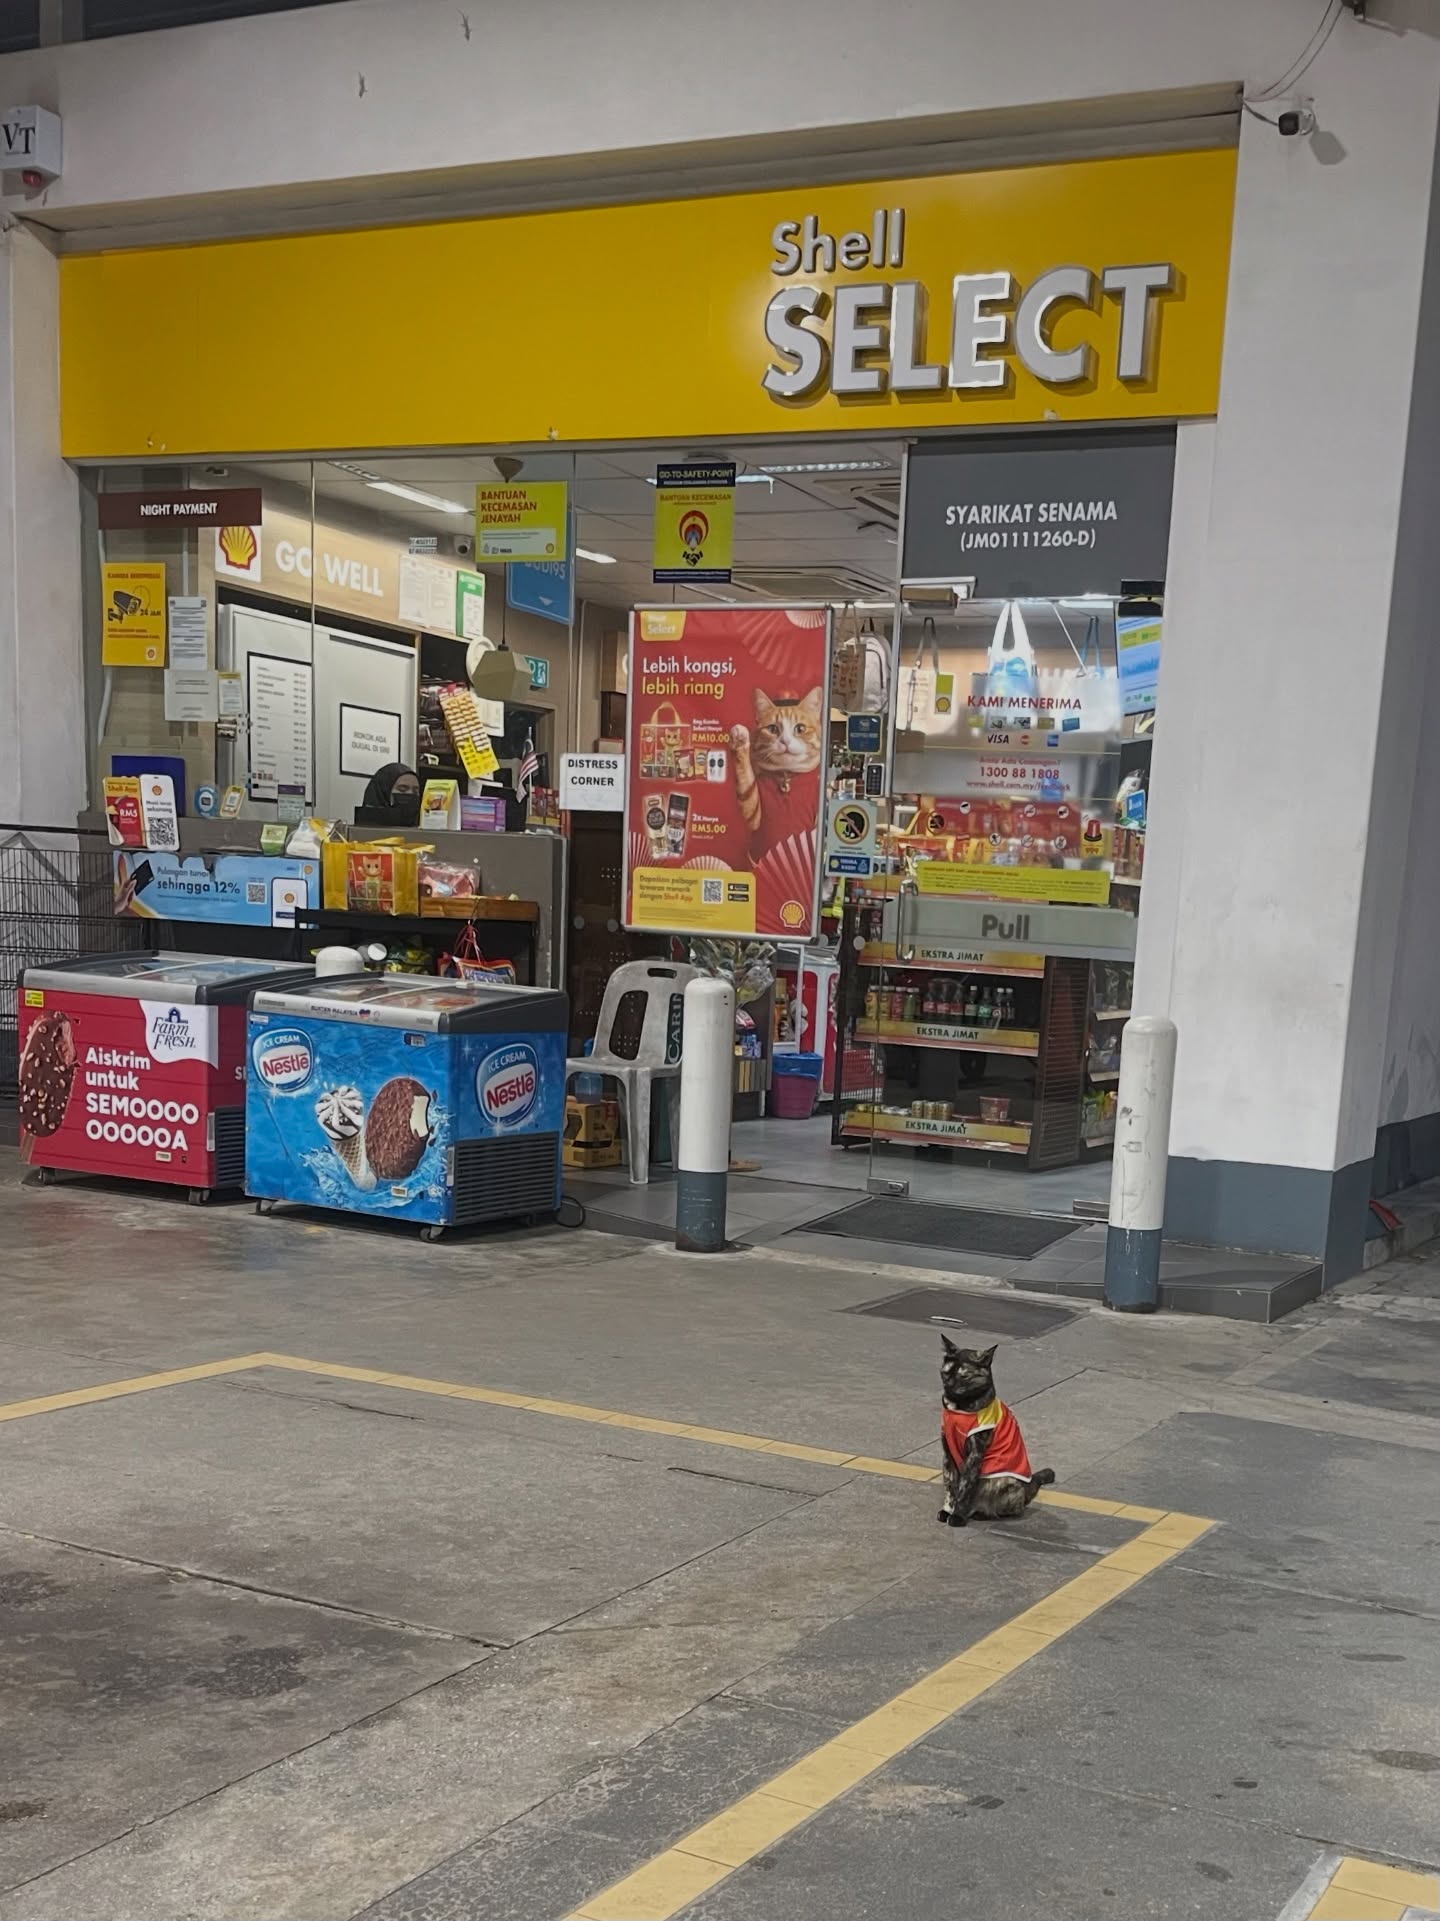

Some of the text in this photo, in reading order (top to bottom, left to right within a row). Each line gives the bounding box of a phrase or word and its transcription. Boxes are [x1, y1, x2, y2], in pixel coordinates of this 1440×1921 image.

[771, 208, 905, 275] Shell
[762, 262, 1180, 396] SELECT
[481, 490, 527, 500] BANTUAN
[140, 502, 218, 516] NIGHT PAYMENT
[481, 501, 537, 512] KECEMASAN
[945, 501, 1118, 526] SYARIKAT SENAMA
[481, 513, 521, 524] JENAYAH
[960, 528, 1096, 552] (JM01111260-D)
[275, 540, 316, 578] GO
[323, 552, 384, 597] WELL
[642, 655, 737, 678] Lebih kongsi,
[642, 676, 725, 700] lebih riang
[967, 695, 1082, 710] KAMI MENERIMA
[691, 733, 730, 742] RM10.00
[987, 734, 1010, 744] VISA
[568, 759, 618, 769] DISTRESS
[980, 766, 1060, 780] 1300 88 1808
[571, 776, 614, 786] CORNER
[120, 808, 138, 818] RM5
[157, 877, 240, 895] sehingga 12%
[981, 914, 1030, 940] Pull
[921, 949, 984, 962] EKSTRA JIMAT
[916, 1026, 979, 1040] EKSTRA JIMAT
[263, 1034, 300, 1049] ICE CREAM
[85, 1047, 150, 1070] Aiskrim
[488, 1050, 527, 1073] ICE CREAM
[86, 1071, 139, 1091] untuk
[86, 1092, 199, 1125] SEMOOOO
[86, 1119, 189, 1151] OOOOOA
[905, 1120, 967, 1135] EKSTRA JIMAT
